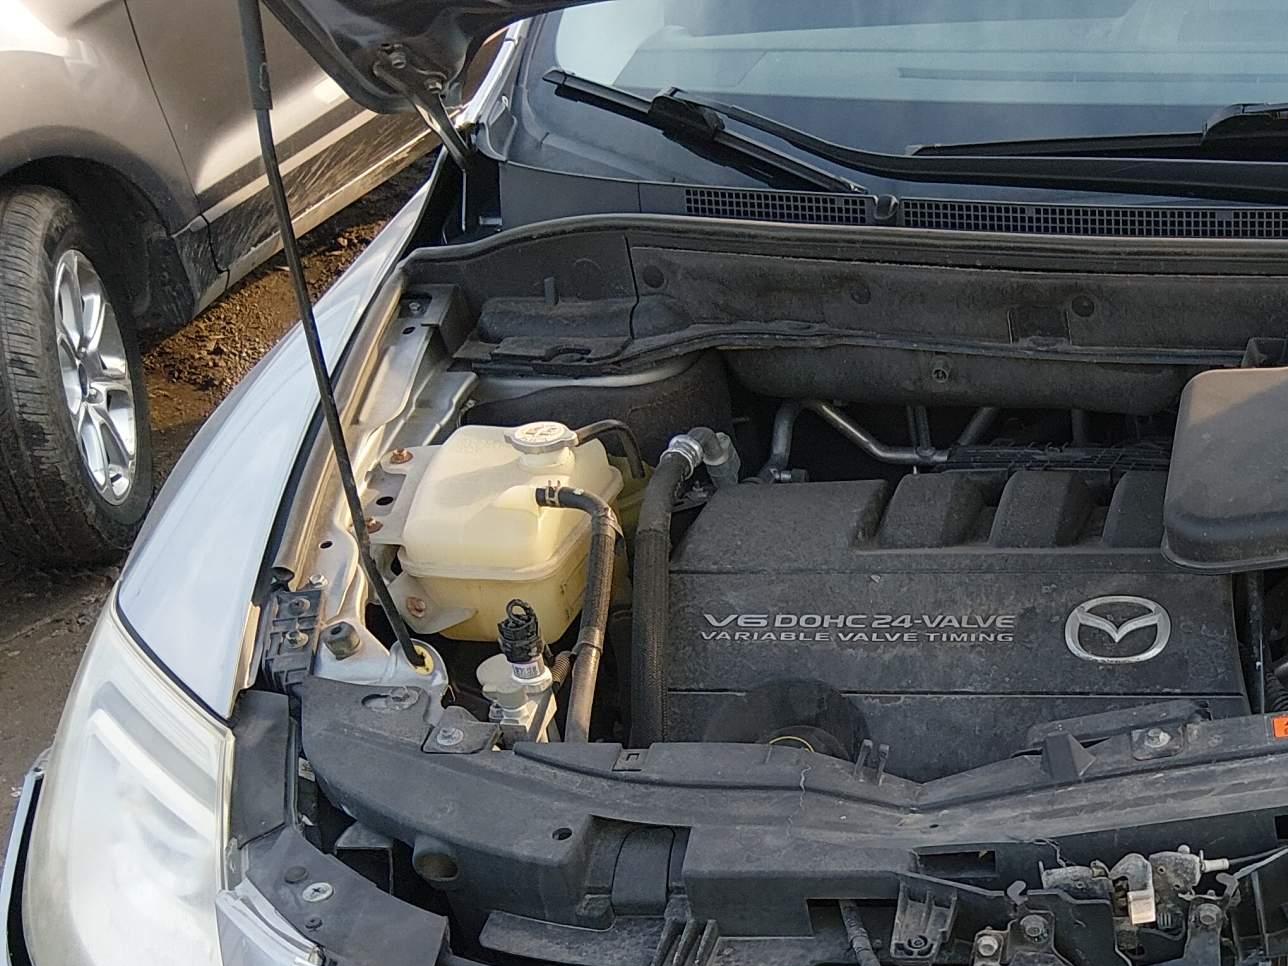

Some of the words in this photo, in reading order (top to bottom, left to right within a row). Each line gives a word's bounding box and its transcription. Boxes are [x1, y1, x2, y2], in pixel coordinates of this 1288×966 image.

[703, 613, 769, 628] V6
[774, 614, 868, 628] DOHC
[871, 614, 1017, 628] 24-VALVE
[700, 631, 830, 641] VARIABLE
[837, 632, 919, 642] VALVE
[925, 632, 1015, 642] TIMING
